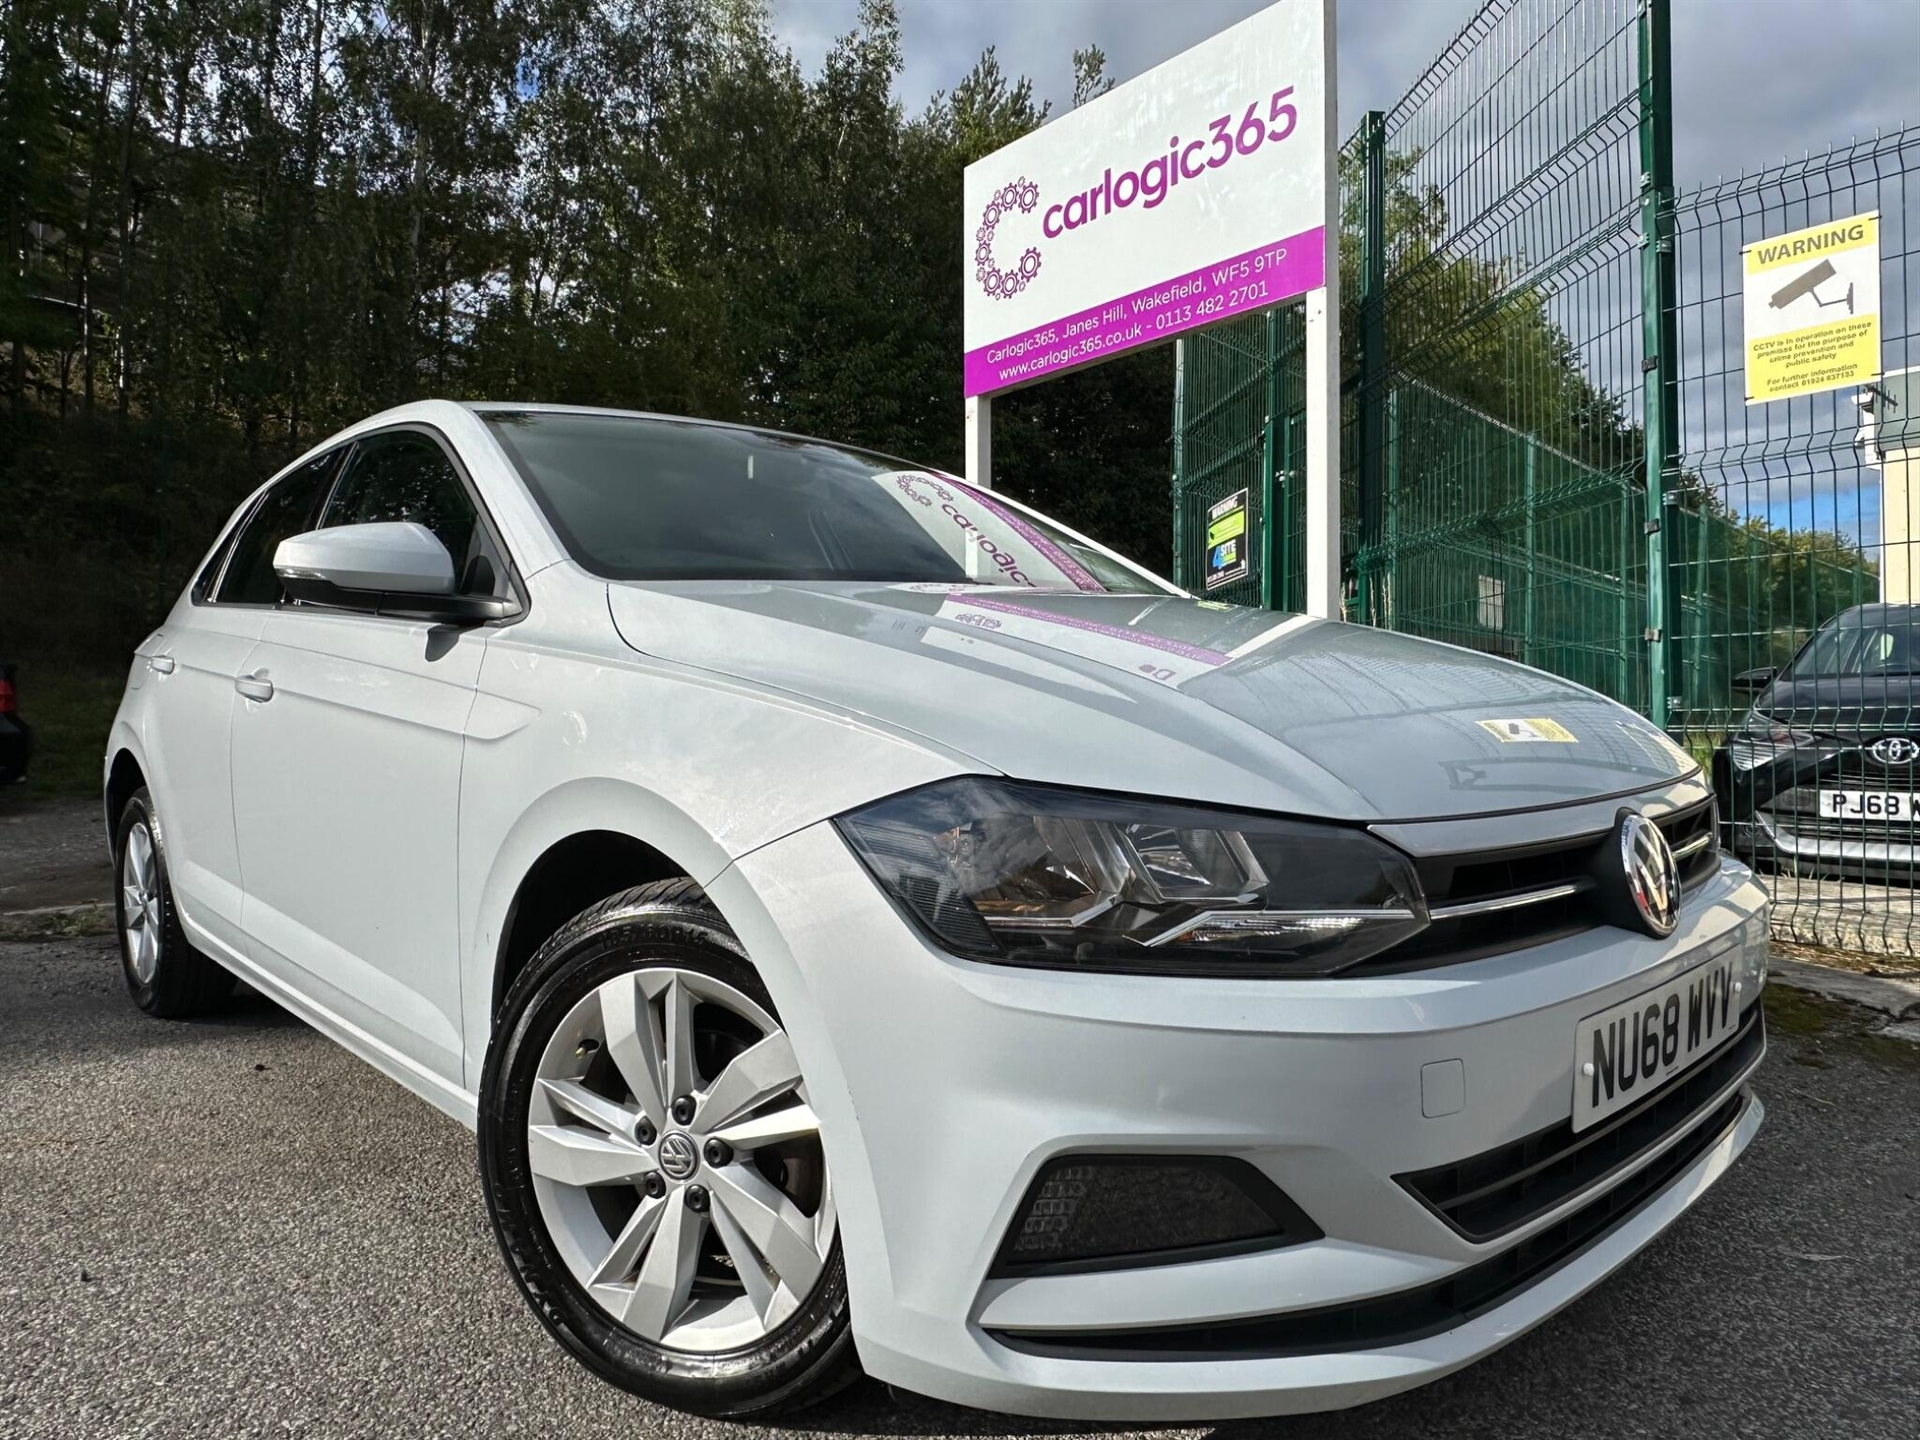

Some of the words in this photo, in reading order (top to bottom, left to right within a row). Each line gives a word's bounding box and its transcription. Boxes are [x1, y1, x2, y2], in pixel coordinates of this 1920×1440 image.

[1043, 85, 1297, 239] carlogic365
[1757, 224, 1864, 264] WARNING
[987, 328, 1059, 364] Carlogic365,
[1062, 316, 1099, 339] Janes
[1103, 304, 1127, 326] Hill,
[1131, 276, 1207, 315] Wakefield,
[1211, 260, 1250, 287] WF5
[1254, 247, 1287, 273] 9TP
[999, 322, 1142, 381] www.carlogic365.co.uk
[1156, 305, 1192, 330] 0113
[1196, 295, 1225, 316] 482
[1228, 280, 1269, 307] 2701
[1753, 340, 1776, 352] CCTV
[1795, 329, 1834, 345] operation
[1835, 326, 1847, 335] on
[1848, 322, 1872, 332] these
[1756, 346, 1793, 360] premises
[1794, 342, 1806, 351] for
[1807, 339, 1821, 348] the
[1822, 333, 1857, 346] purpose
[1858, 329, 1868, 338] of
[1769, 353, 1792, 363] crime
[1793, 345, 1837, 360] prevention
[1837, 340, 1855, 350] and
[1785, 357, 1811, 369] public
[1811, 351, 1837, 363] safety
[1766, 377, 1781, 386] For
[1782, 371, 1809, 383] further
[1810, 363, 1858, 379] information
[1769, 381, 1799, 392] contact
[1592, 992, 1681, 1109] NU68
